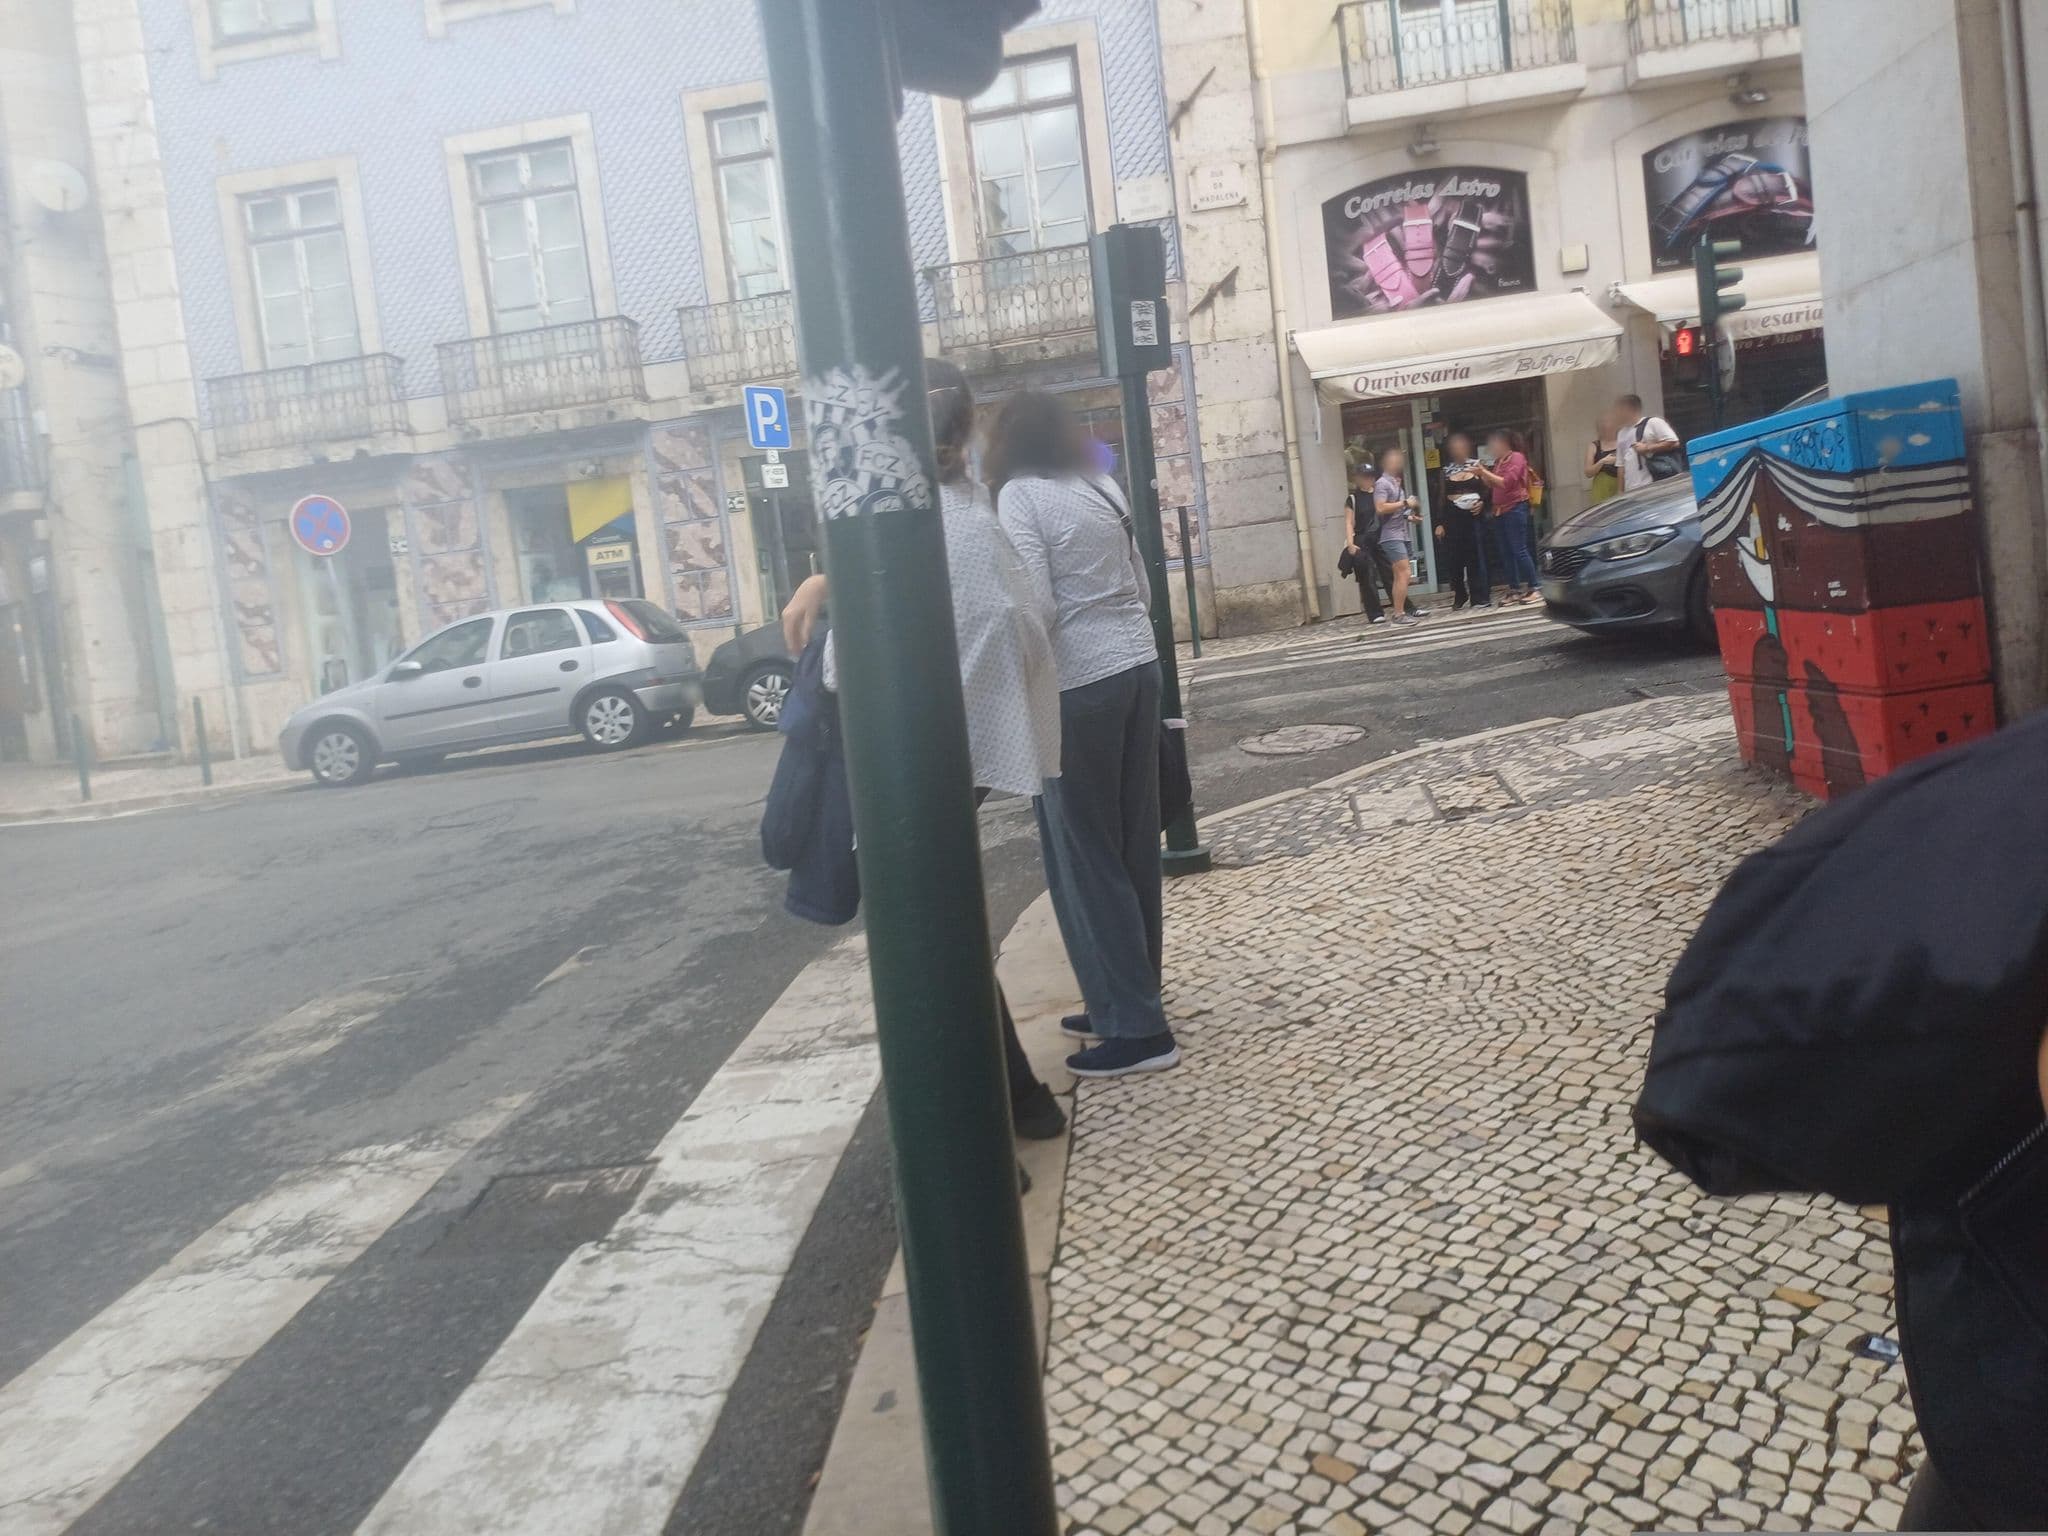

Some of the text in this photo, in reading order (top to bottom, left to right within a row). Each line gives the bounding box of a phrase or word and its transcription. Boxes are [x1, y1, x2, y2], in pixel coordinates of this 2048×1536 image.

[1344, 176, 1501, 219] Correias Astro
[1353, 362, 1471, 394] Ourivesaria
[753, 392, 779, 442] P
[860, 450, 900, 473] FCZ
[595, 548, 625, 561] ATM
